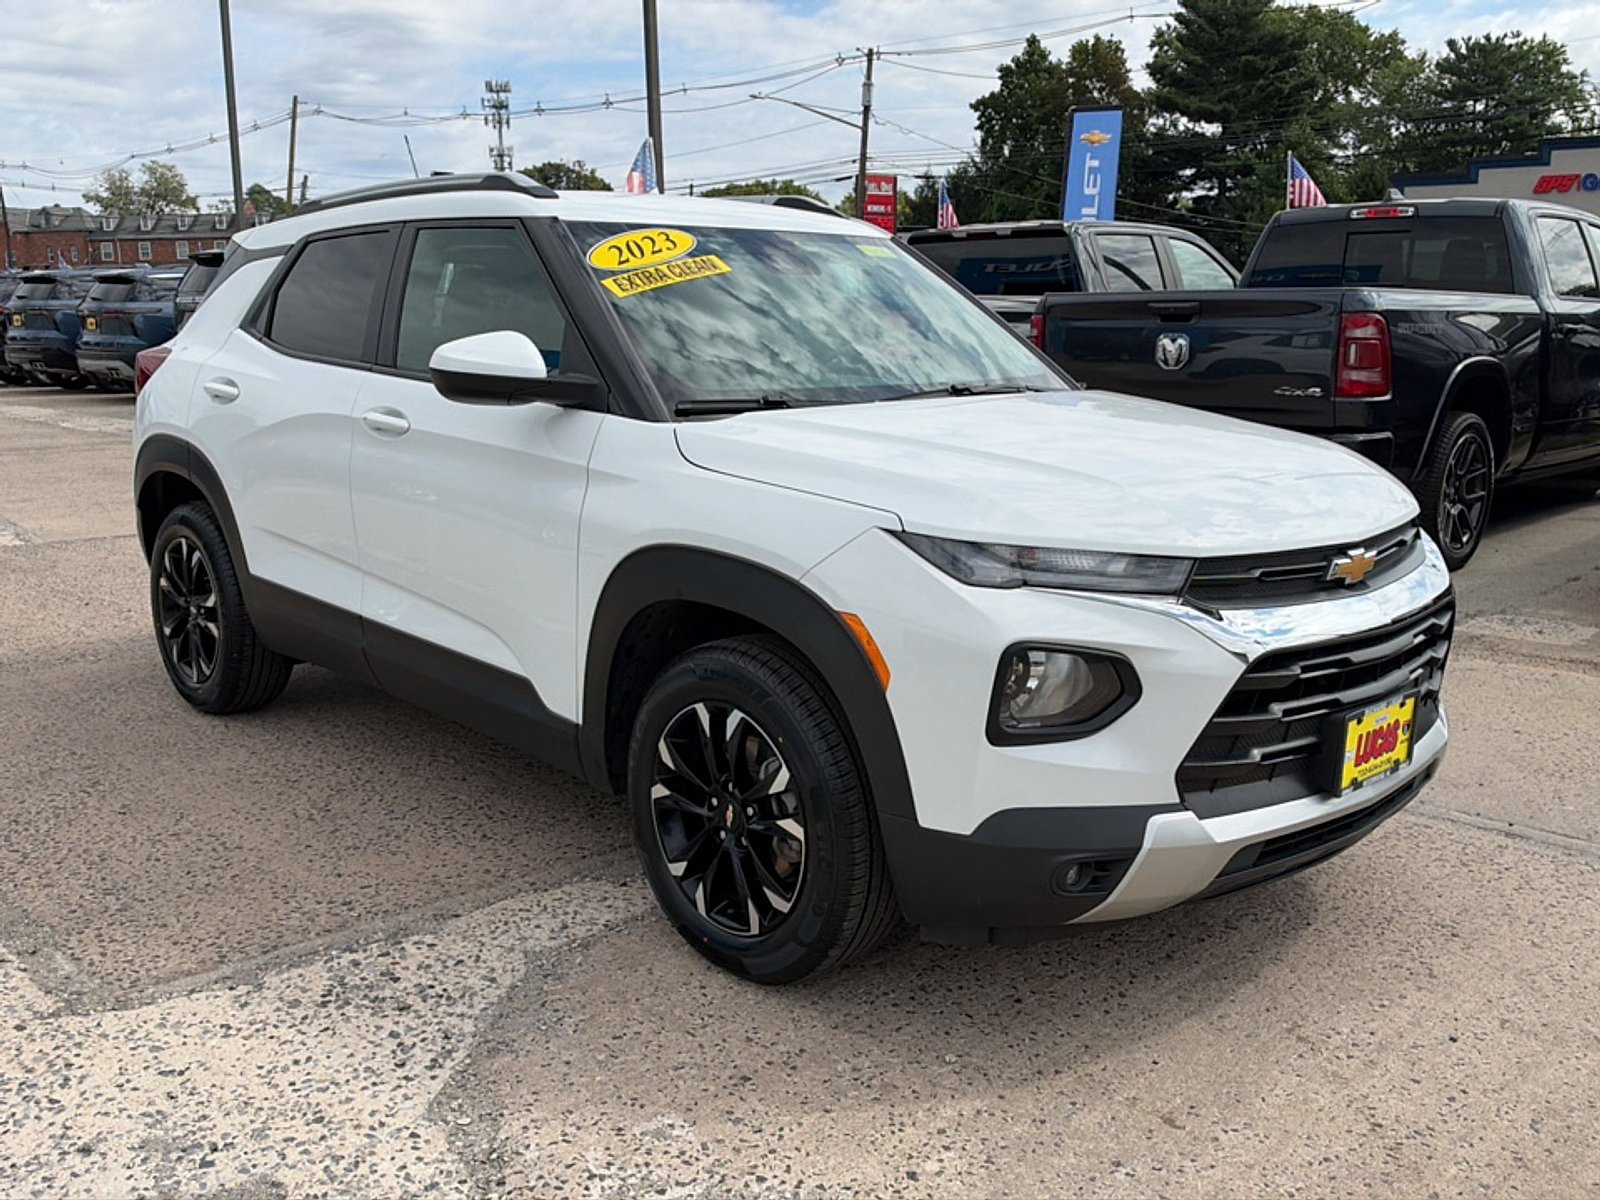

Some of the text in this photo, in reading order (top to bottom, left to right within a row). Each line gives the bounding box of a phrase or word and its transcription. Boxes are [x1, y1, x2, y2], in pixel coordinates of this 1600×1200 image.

[607, 231, 677, 266] 2023
[613, 257, 720, 293] EXTRA CLEAN
[1354, 718, 1401, 768] LUCAS
